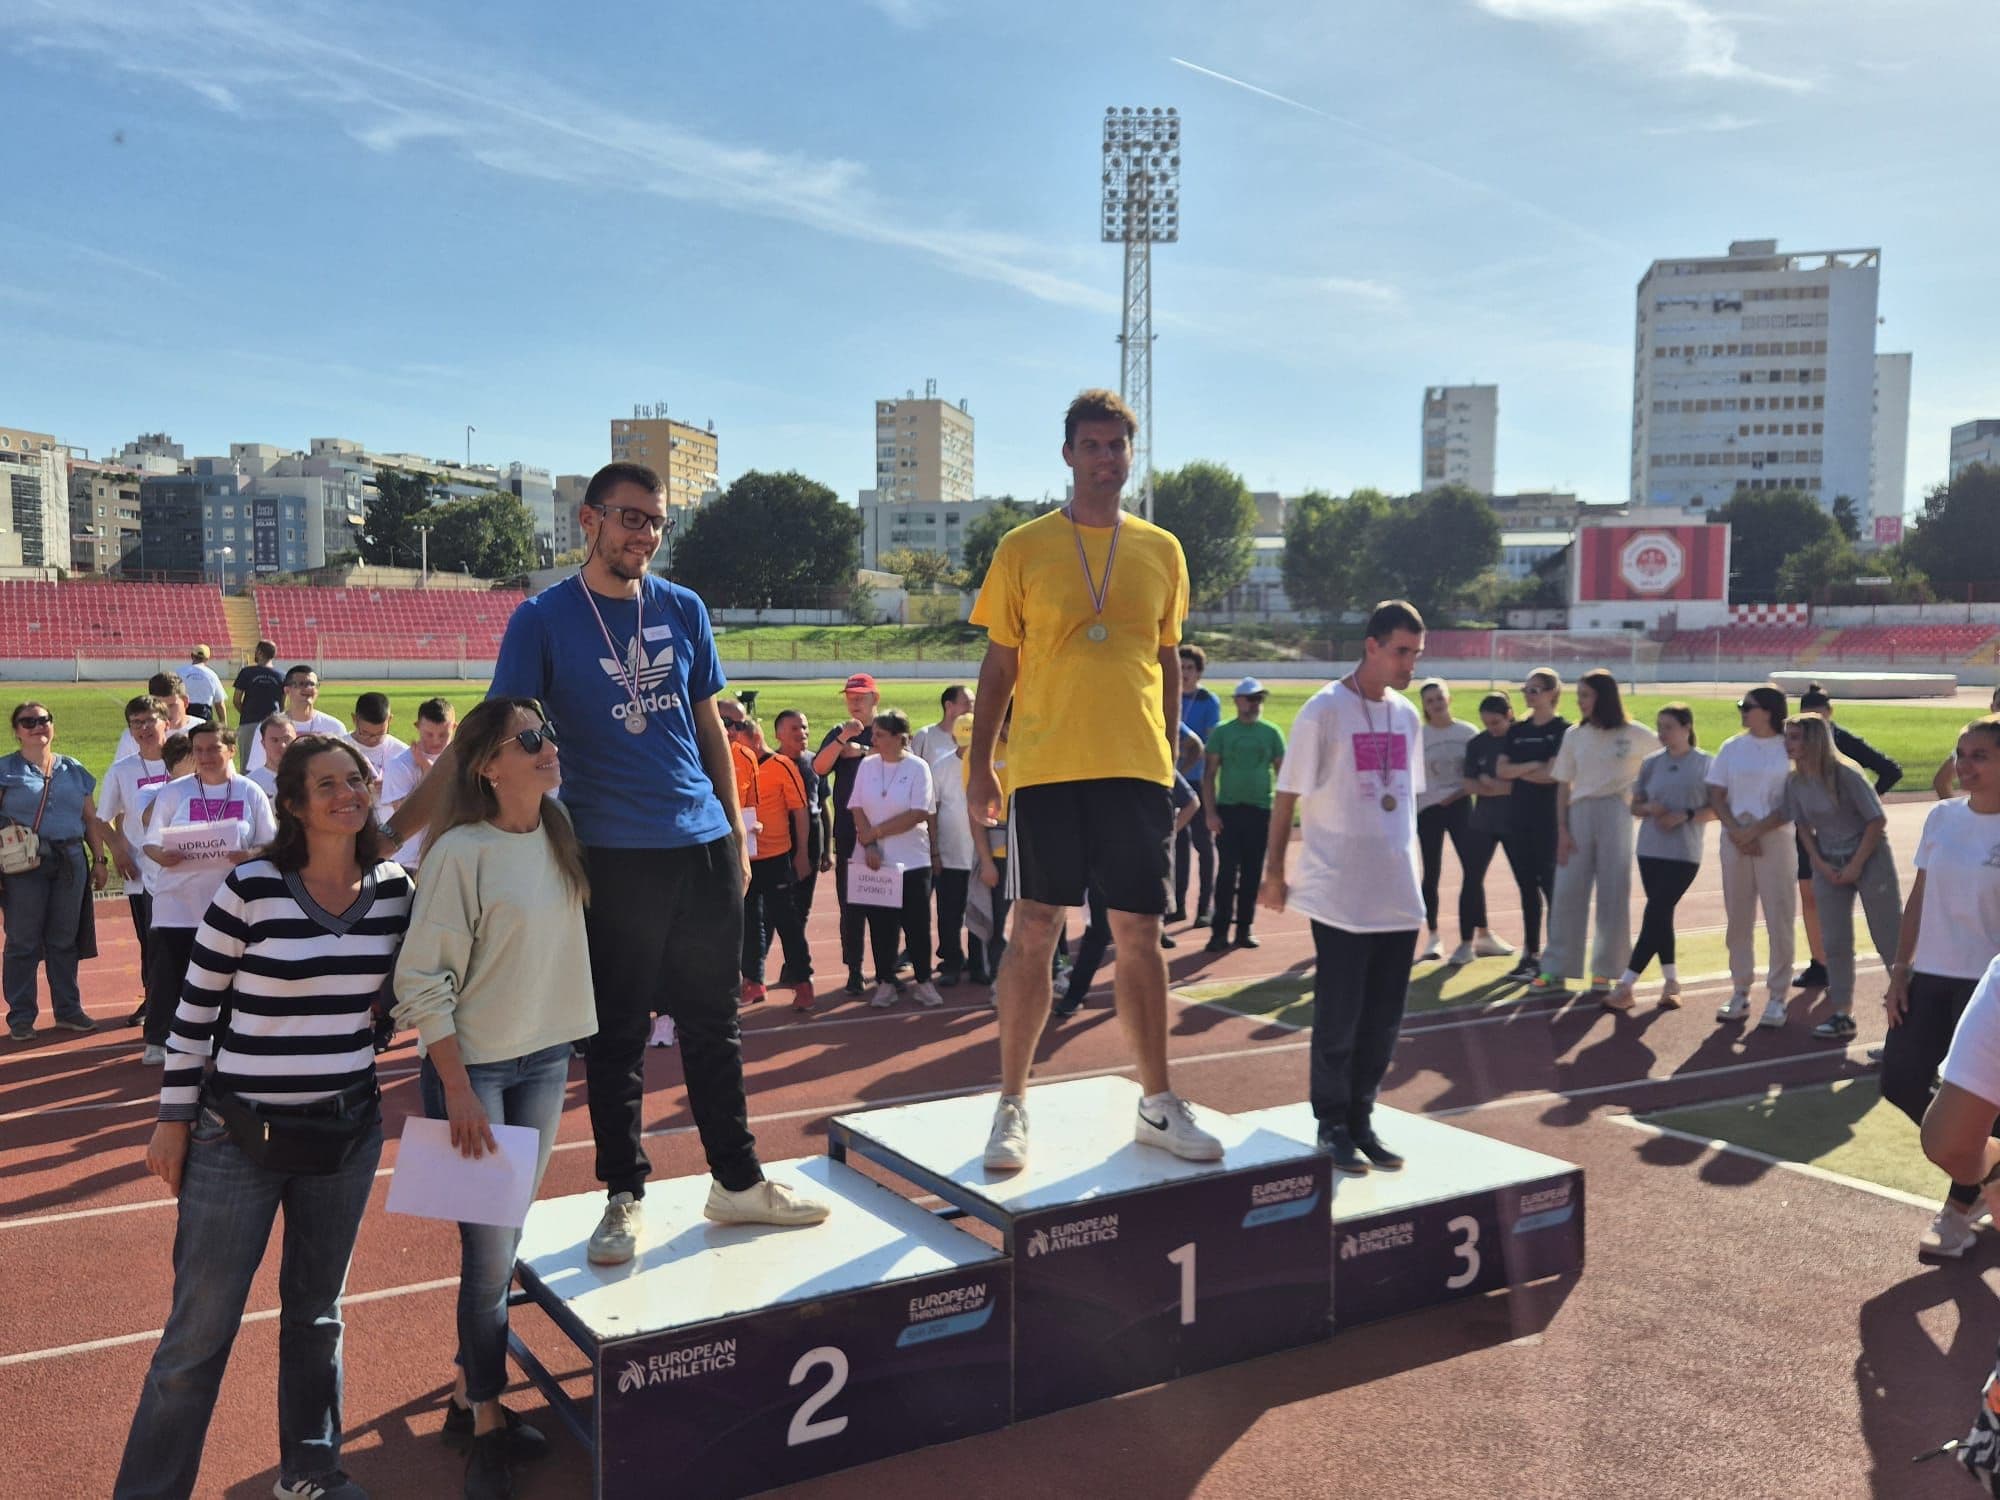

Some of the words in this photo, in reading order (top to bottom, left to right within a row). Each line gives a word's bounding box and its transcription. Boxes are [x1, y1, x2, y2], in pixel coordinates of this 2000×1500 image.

[611, 692, 682, 720] adidas
[178, 838, 227, 851] UDRUGA
[1251, 1174, 1314, 1197] EUROPEAN
[1050, 1213, 1119, 1239] EUROPEAN
[1050, 1226, 1119, 1252] ATHLETICS
[1359, 1222, 1414, 1242] EUROPEAN
[1357, 1232, 1414, 1255] ATHLETICS
[1446, 1215, 1480, 1289] 3
[1167, 1242, 1196, 1325] 1
[909, 1283, 987, 1312] EUROPEAN
[909, 1302, 962, 1323] THROWING
[963, 1297, 985, 1310] CUP
[648, 1338, 737, 1370] EUROPEAN
[648, 1352, 737, 1386] ATHLETICS
[787, 1346, 848, 1446] 2
